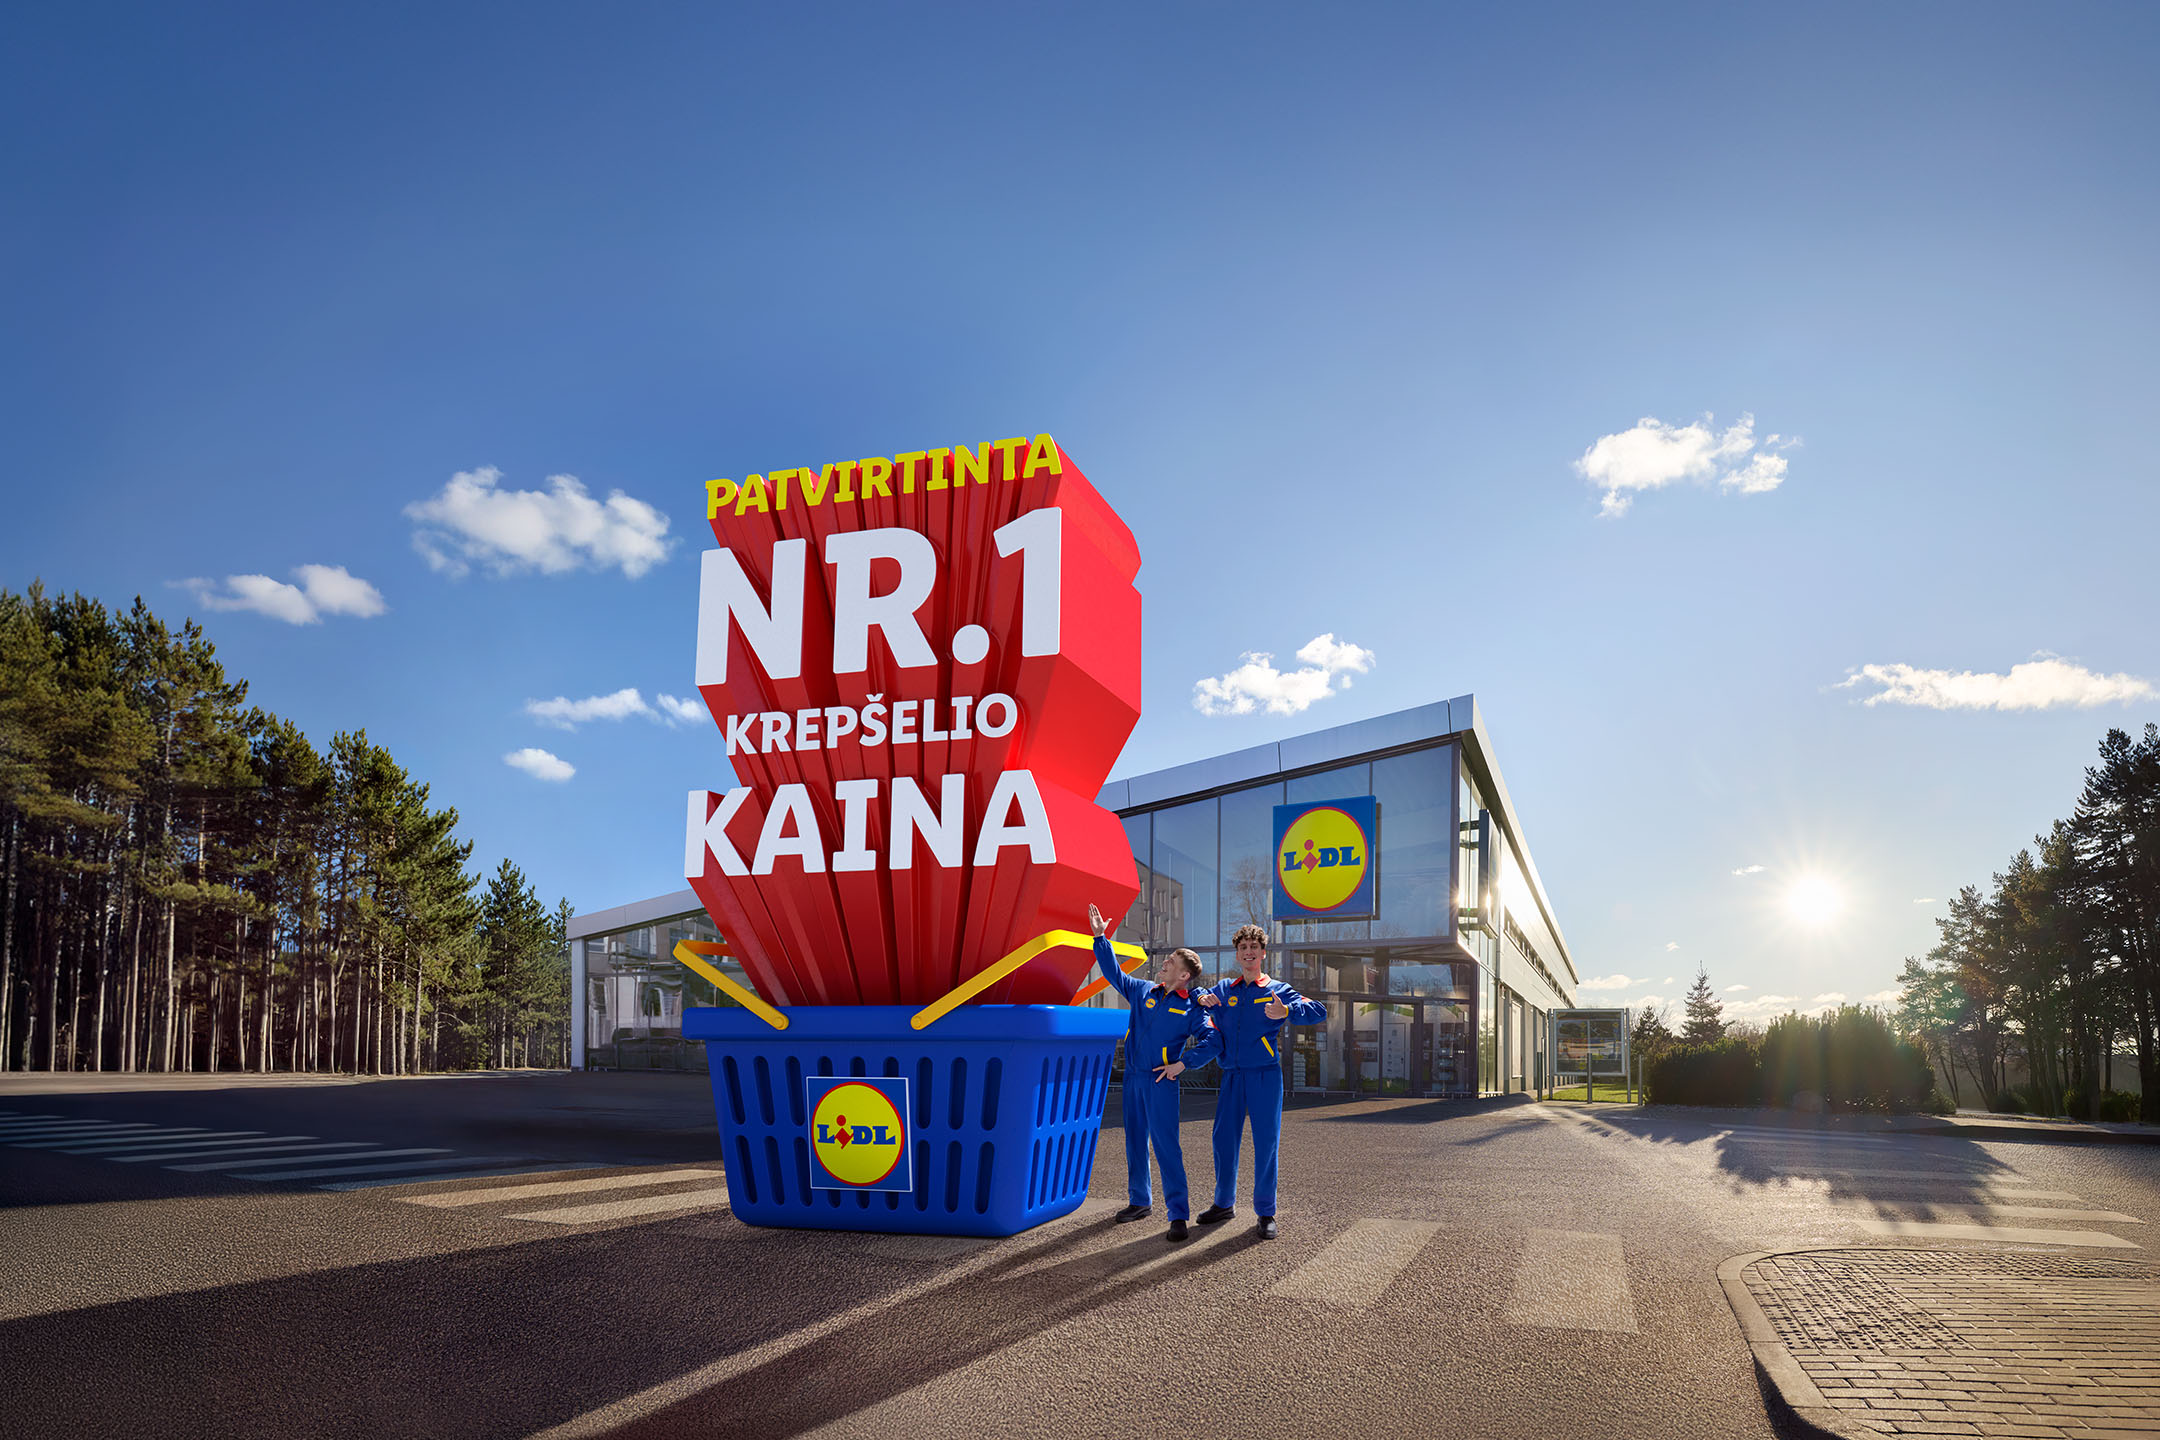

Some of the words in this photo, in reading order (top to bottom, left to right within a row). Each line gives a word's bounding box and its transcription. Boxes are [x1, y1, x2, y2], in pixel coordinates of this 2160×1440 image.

[705, 433, 1062, 519] PATVIRTINTA
[695, 506, 1062, 686] NR.1
[726, 693, 1018, 756] KREPŠELIO
[684, 769, 1056, 878] KAINA
